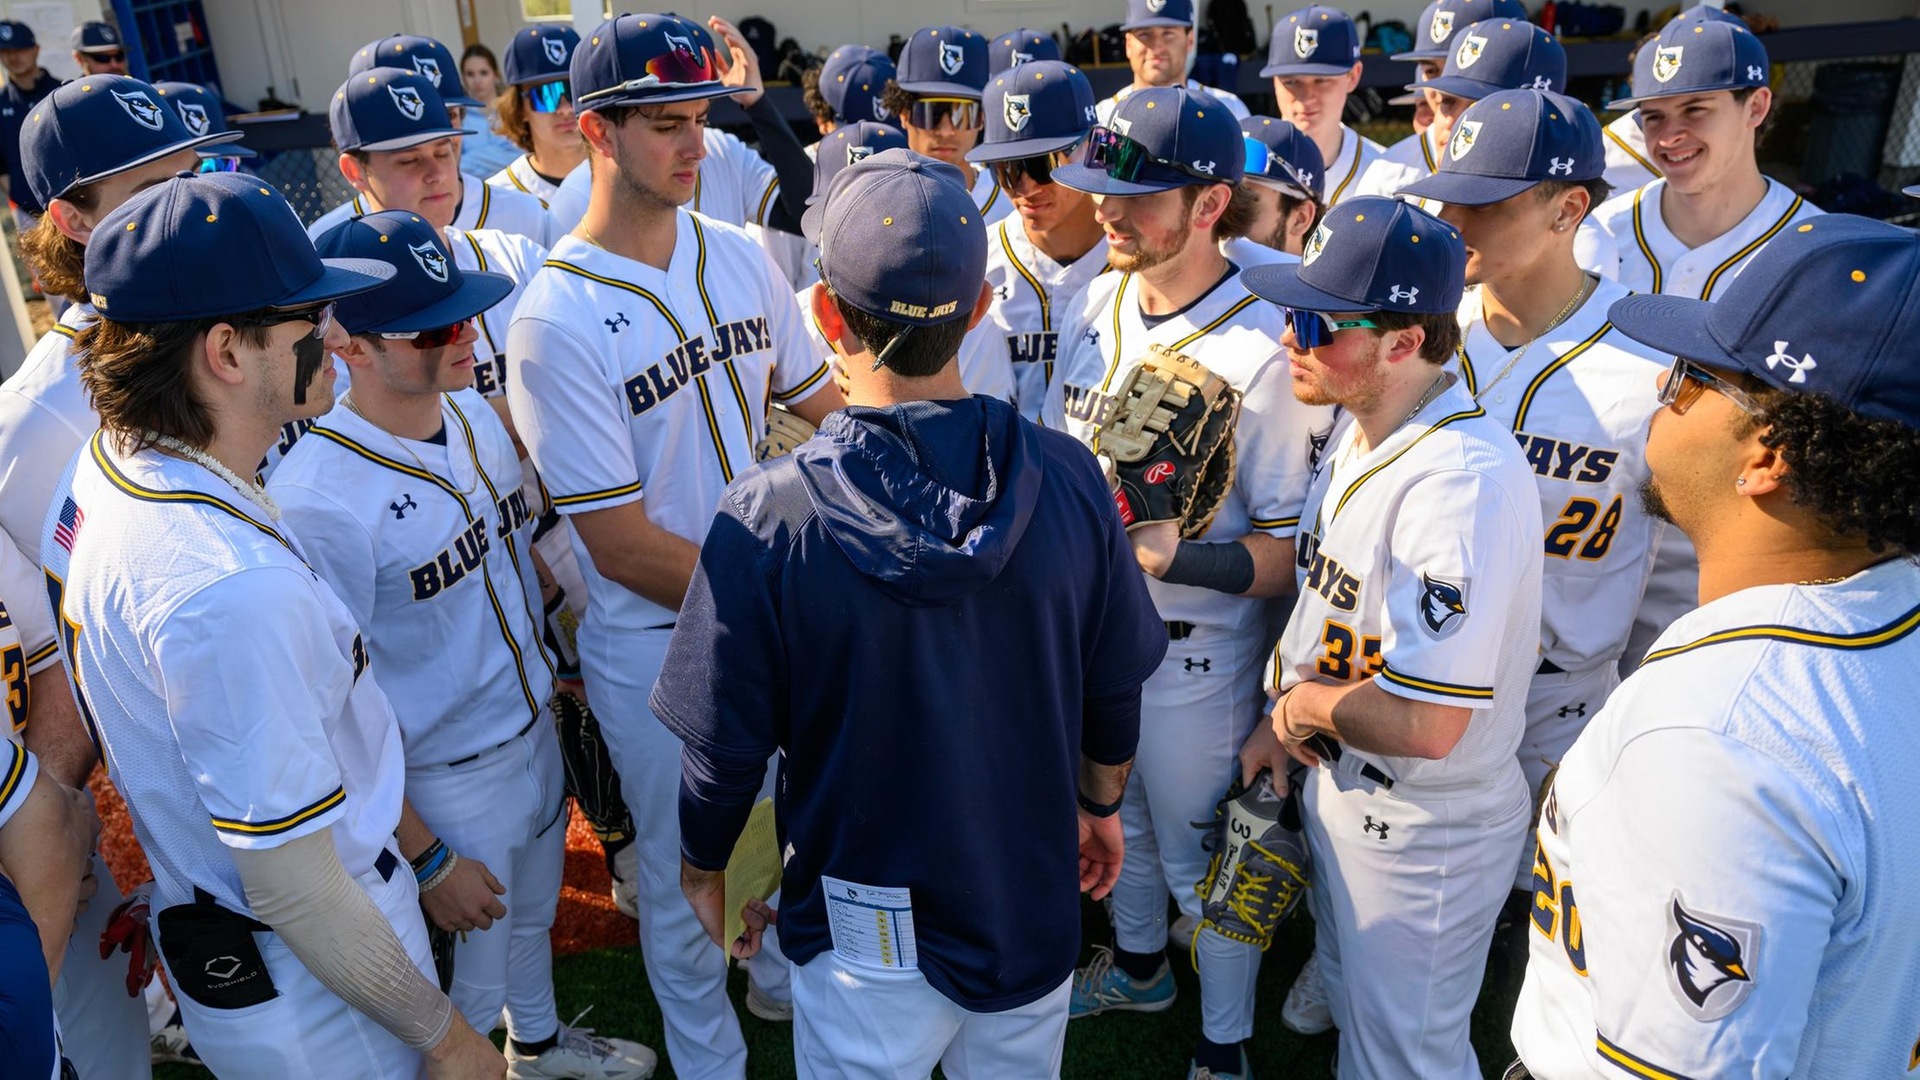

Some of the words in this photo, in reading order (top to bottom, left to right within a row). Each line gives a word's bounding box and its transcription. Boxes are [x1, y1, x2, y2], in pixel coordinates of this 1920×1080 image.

[890, 300, 928, 318] BLUE
[929, 300, 958, 318] JAYS
[624, 335, 711, 417] BLUE
[1007, 331, 1059, 363] LUE
[1513, 430, 1620, 485] AYS
[408, 514, 490, 602] BLUE
[496, 486, 531, 539] JA
[1544, 492, 1623, 562] 28
[1306, 551, 1362, 613] AYS
[207, 971, 258, 989] EVOSHIELD
